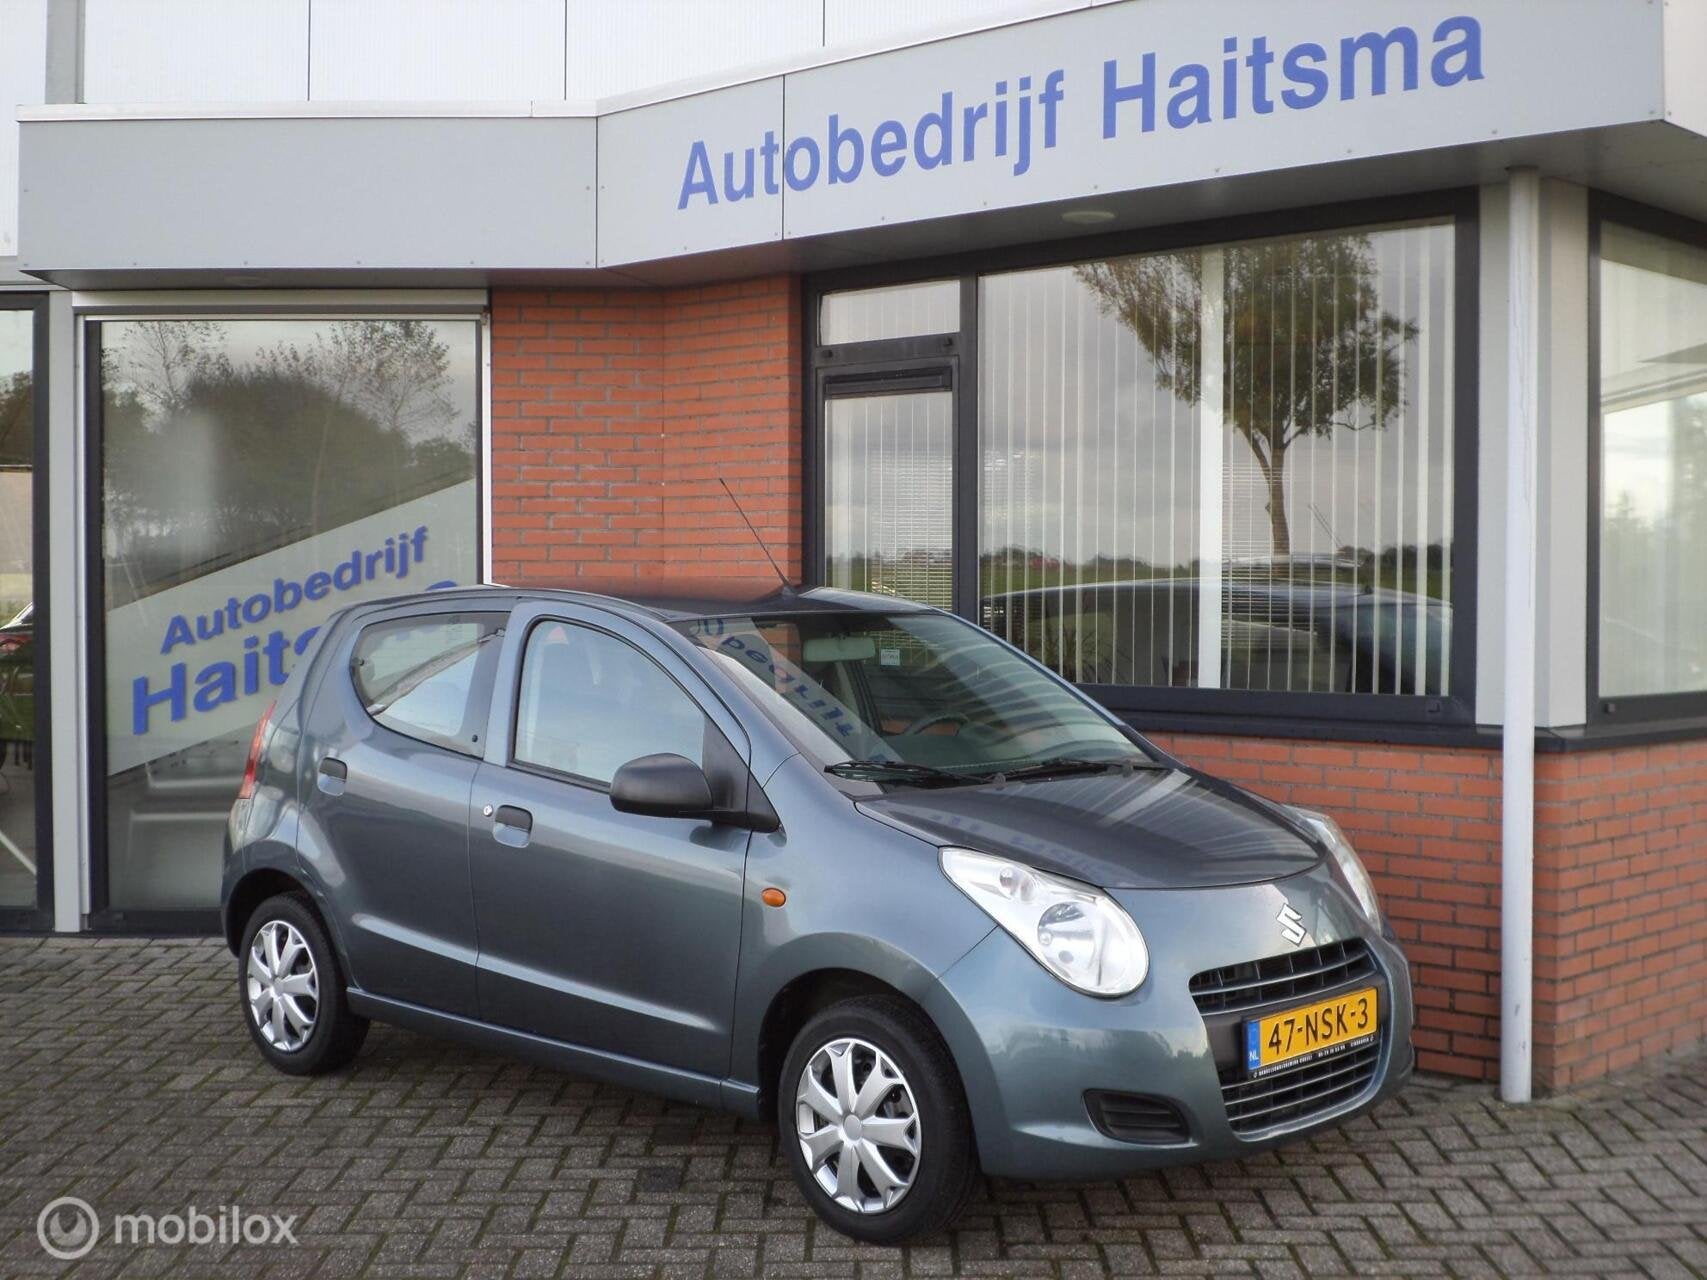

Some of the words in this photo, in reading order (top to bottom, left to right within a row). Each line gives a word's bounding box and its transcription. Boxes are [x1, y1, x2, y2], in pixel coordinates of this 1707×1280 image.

[677, 69, 1064, 210] Autobedrijf
[1102, 15, 1485, 140] Haitsma
[160, 526, 428, 655] Autobedrijf
[1268, 998, 1368, 1056] 47-NSK-3
